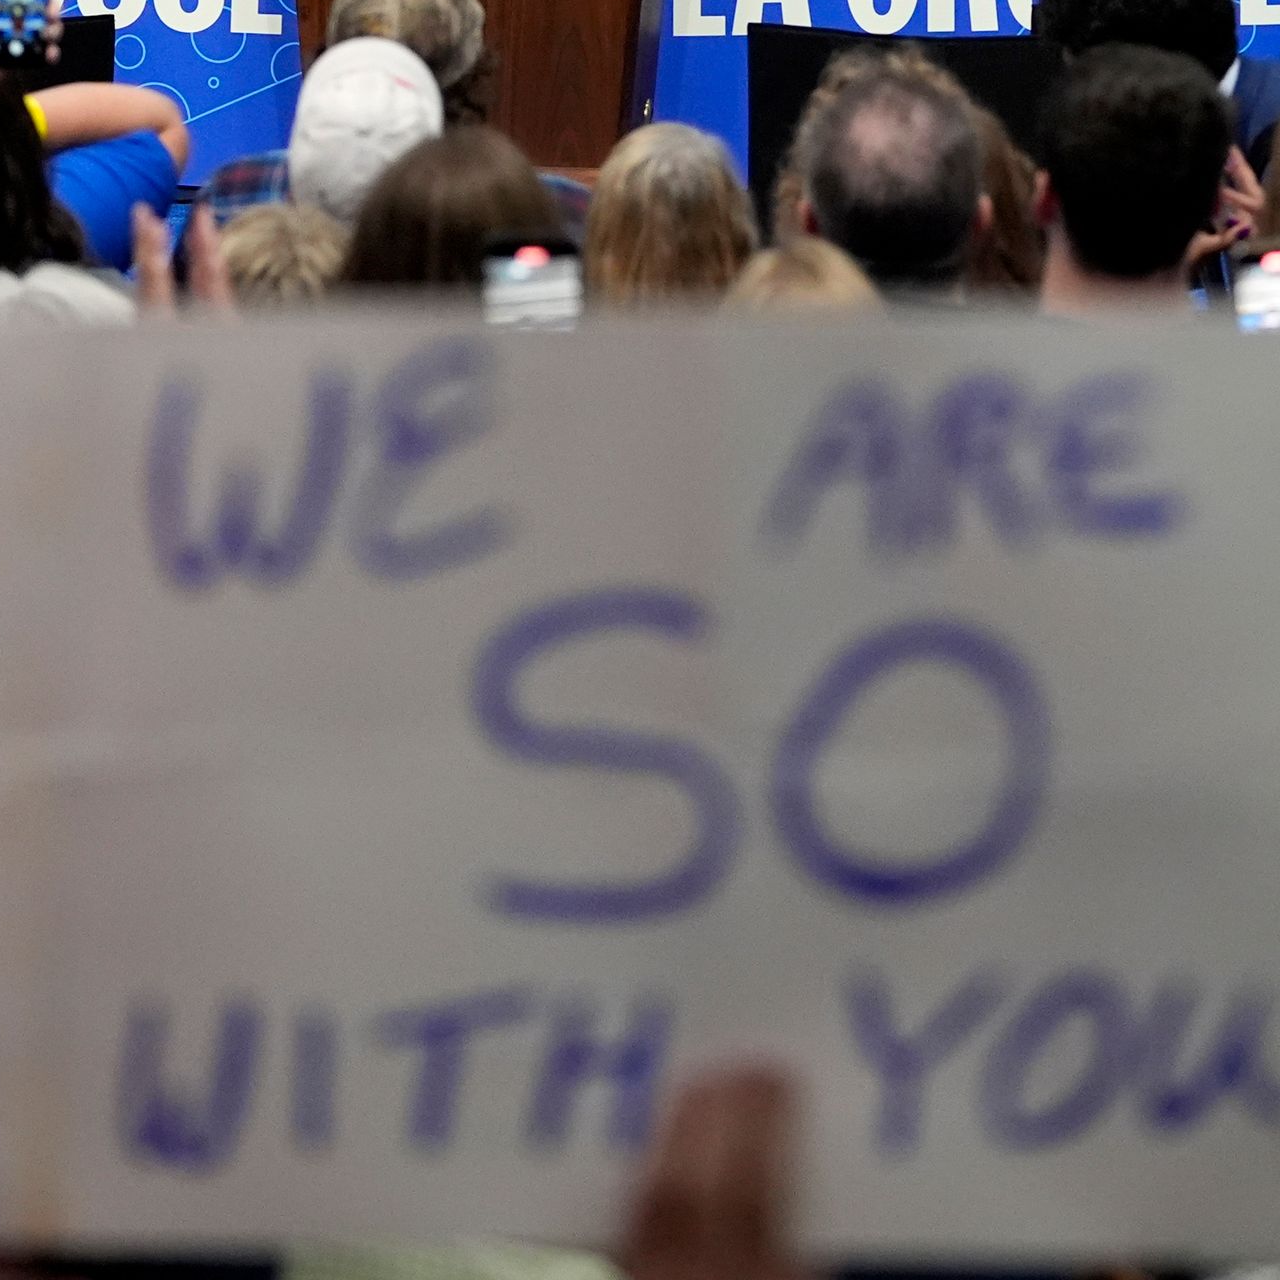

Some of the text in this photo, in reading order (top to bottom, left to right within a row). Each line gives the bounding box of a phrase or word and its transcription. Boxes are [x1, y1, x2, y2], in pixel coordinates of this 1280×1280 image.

[144, 334, 1188, 590] WE ARE
[471, 584, 1054, 925] SO
[119, 981, 676, 1173] WITH
